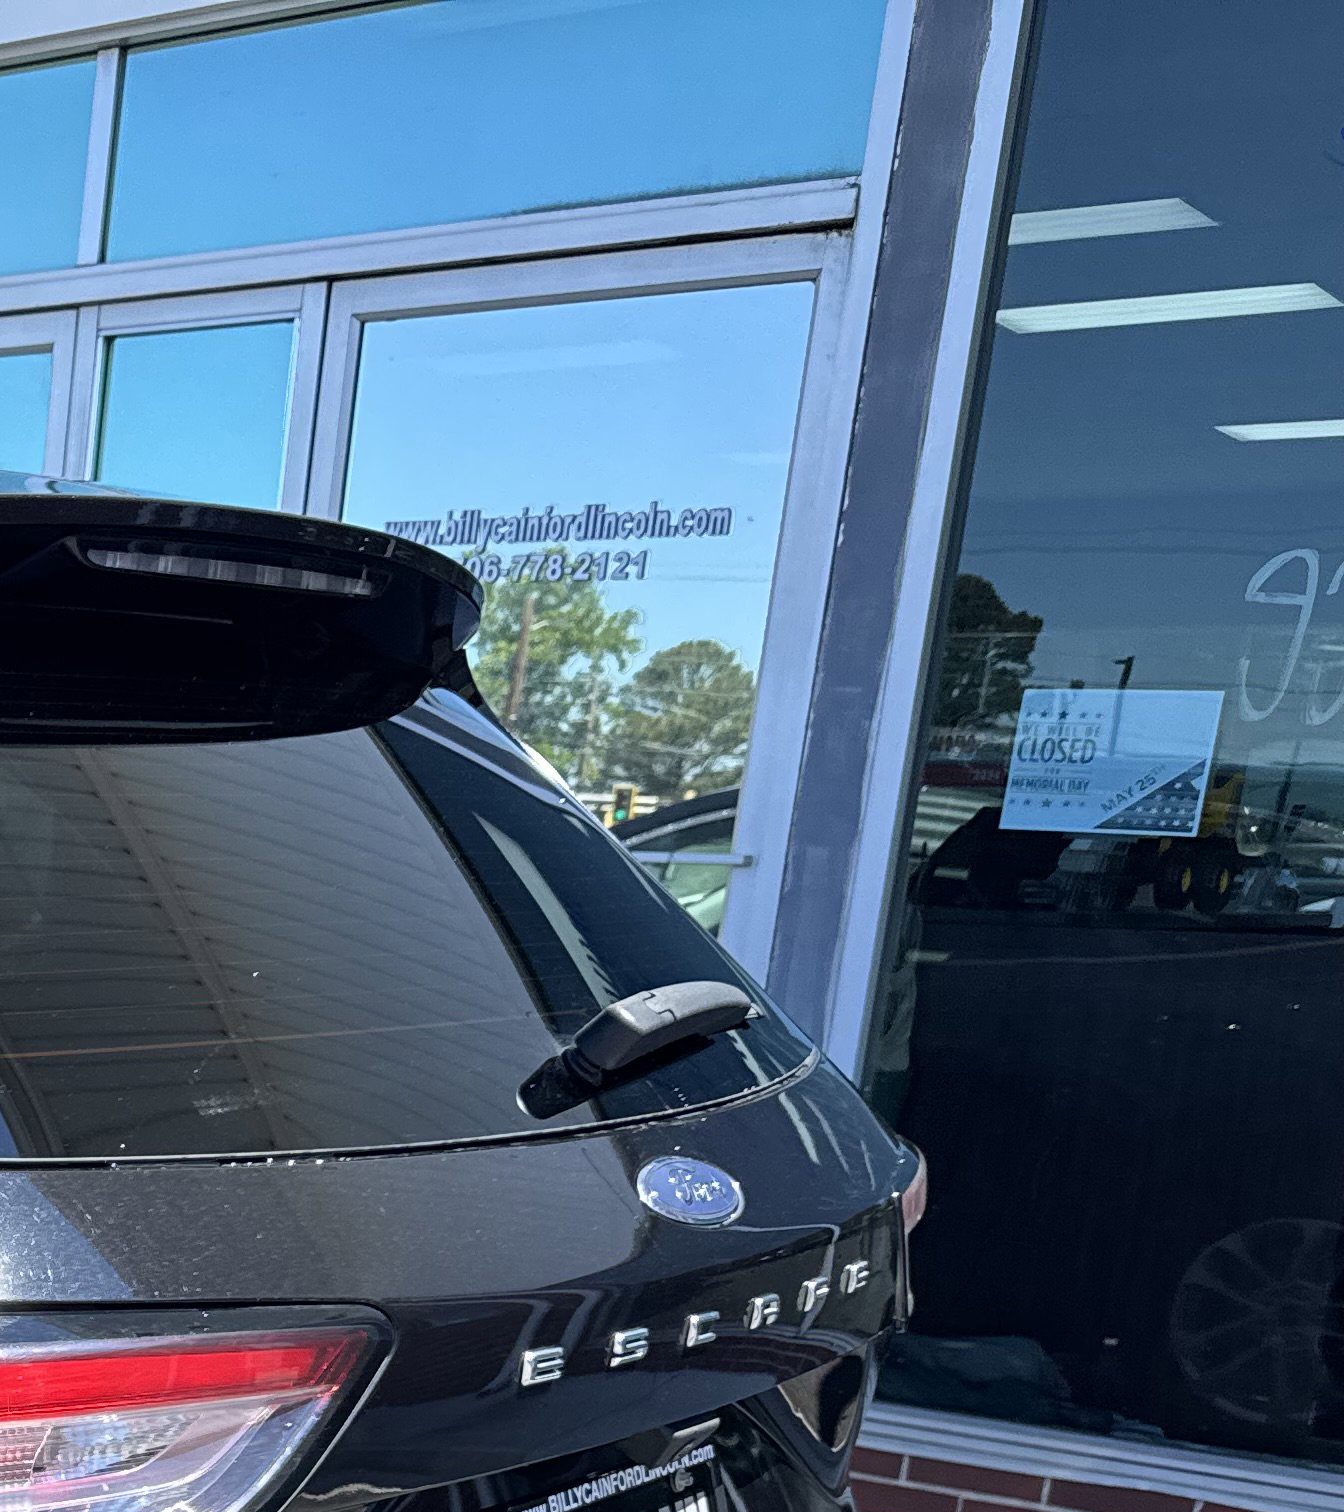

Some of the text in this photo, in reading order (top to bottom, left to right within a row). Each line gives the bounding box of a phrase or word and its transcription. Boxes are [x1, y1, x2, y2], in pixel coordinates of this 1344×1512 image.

[385, 501, 733, 552] www.billycainfordlincoln.com
[459, 549, 649, 584] 06-778-2121
[1017, 736, 1097, 764] CLOSED
[1100, 787, 1135, 812] MAY
[516, 1260, 870, 1388] ESCAPE
